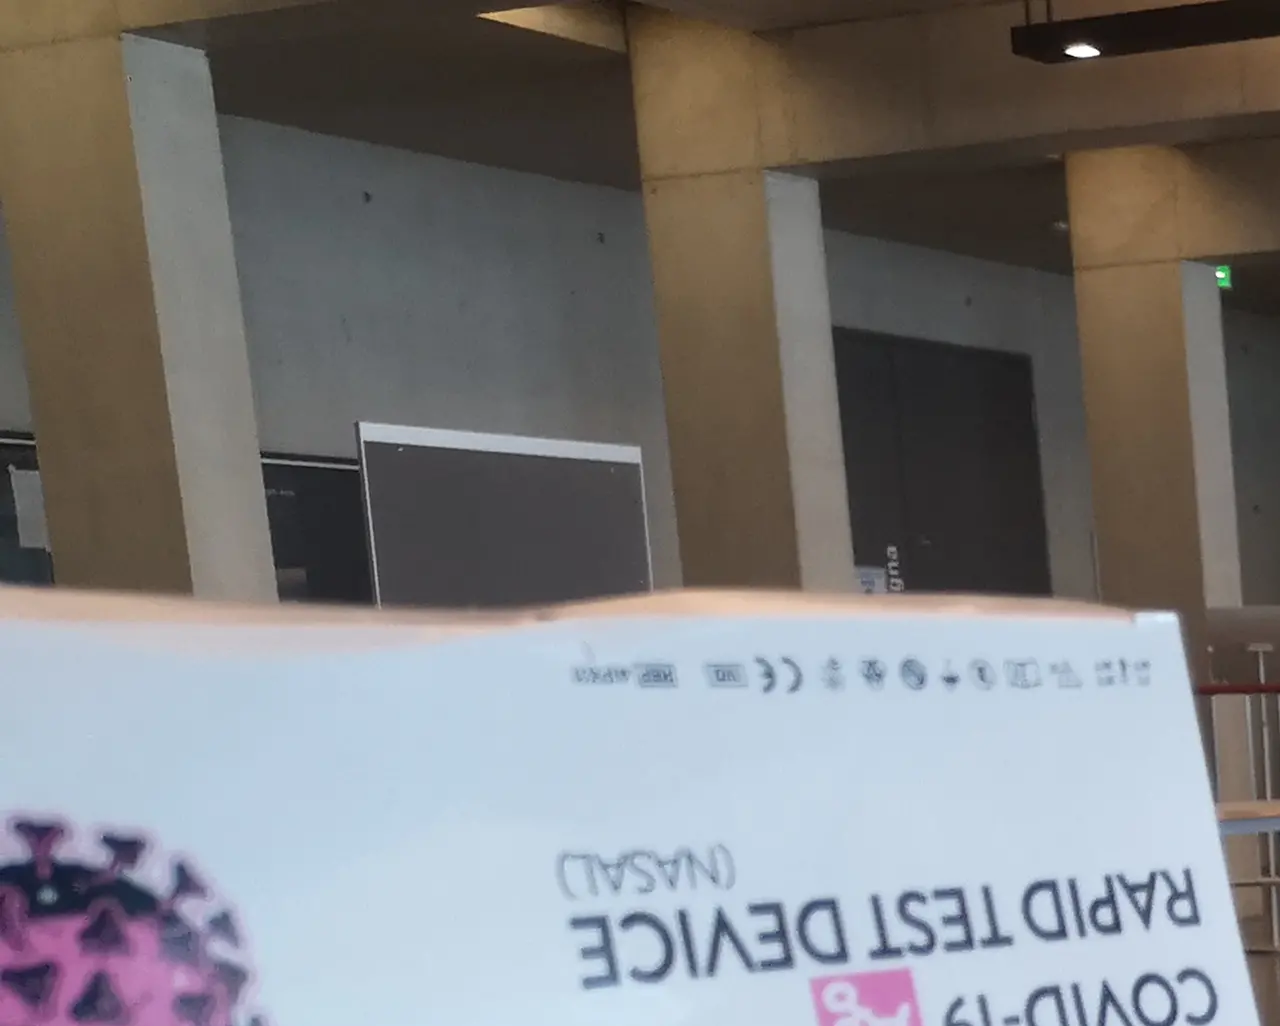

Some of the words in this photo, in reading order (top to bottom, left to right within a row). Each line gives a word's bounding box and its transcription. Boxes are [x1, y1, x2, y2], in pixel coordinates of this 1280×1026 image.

[556, 843, 737, 900] (NASAL)
[1022, 867, 1202, 944] RAPID
[569, 898, 850, 991] DEVICE
[870, 886, 1013, 962] TEST
